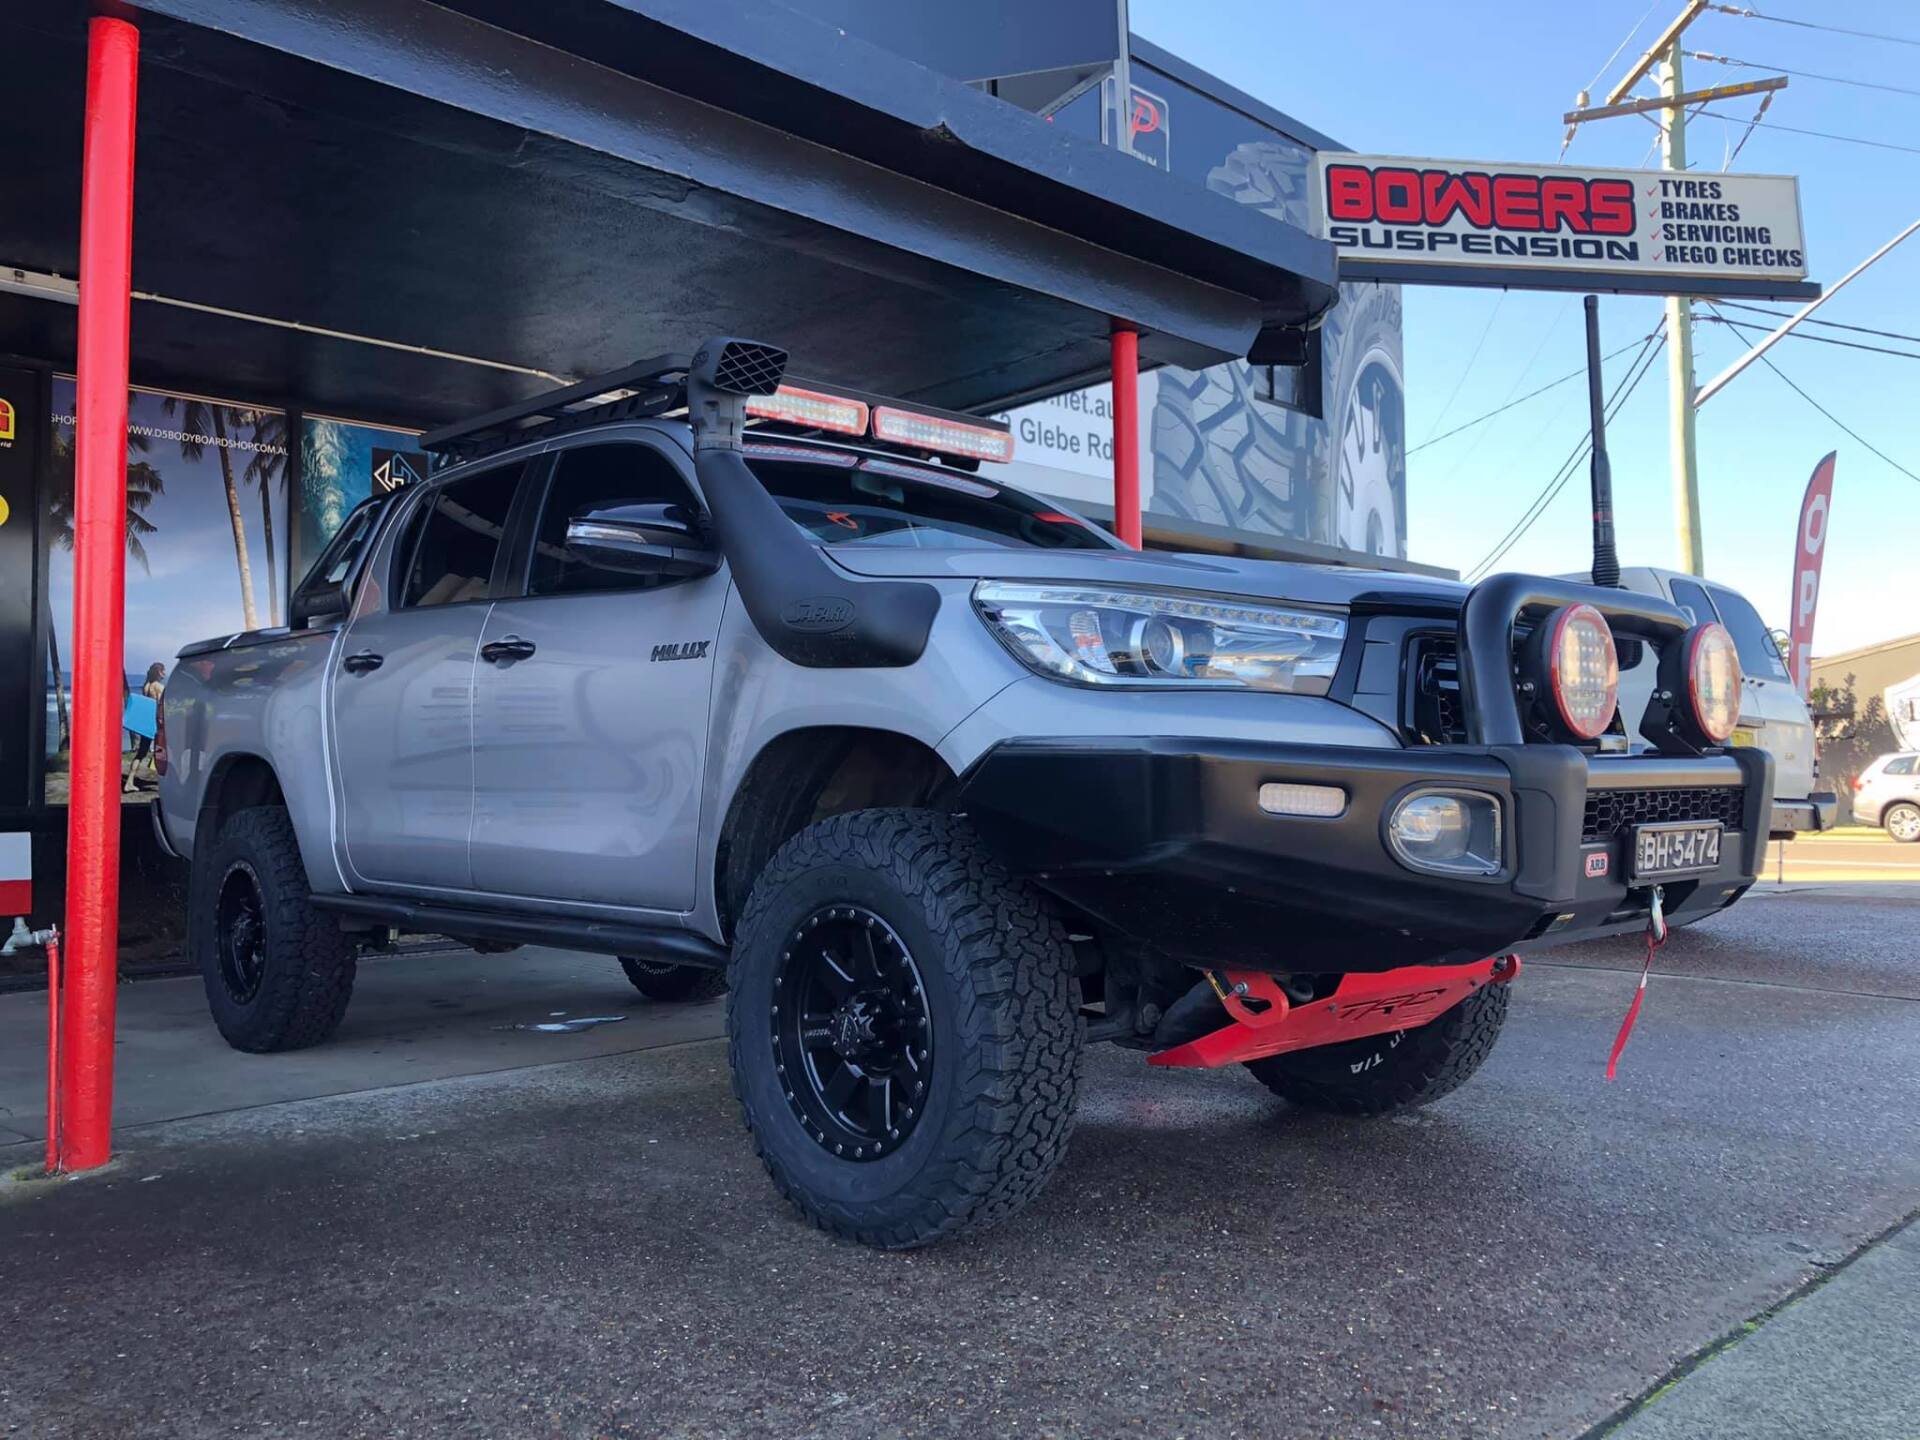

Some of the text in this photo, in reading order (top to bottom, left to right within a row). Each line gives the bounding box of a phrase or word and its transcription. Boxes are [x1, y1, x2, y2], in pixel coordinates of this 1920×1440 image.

[1325, 164, 1636, 237] BOWERS
[1658, 179, 1722, 200] TYRES
[1660, 201, 1741, 223] BRAKES
[1328, 226, 1640, 261] SUSPENSION
[1663, 223, 1772, 245] SERVICING
[1664, 245, 1803, 269] REGO CHECKS
[1020, 418, 1081, 454] Glebe
[1087, 432, 1113, 460] Rd
[650, 640, 711, 662] HILUX
[1350, 1053, 1384, 1074] T/A
